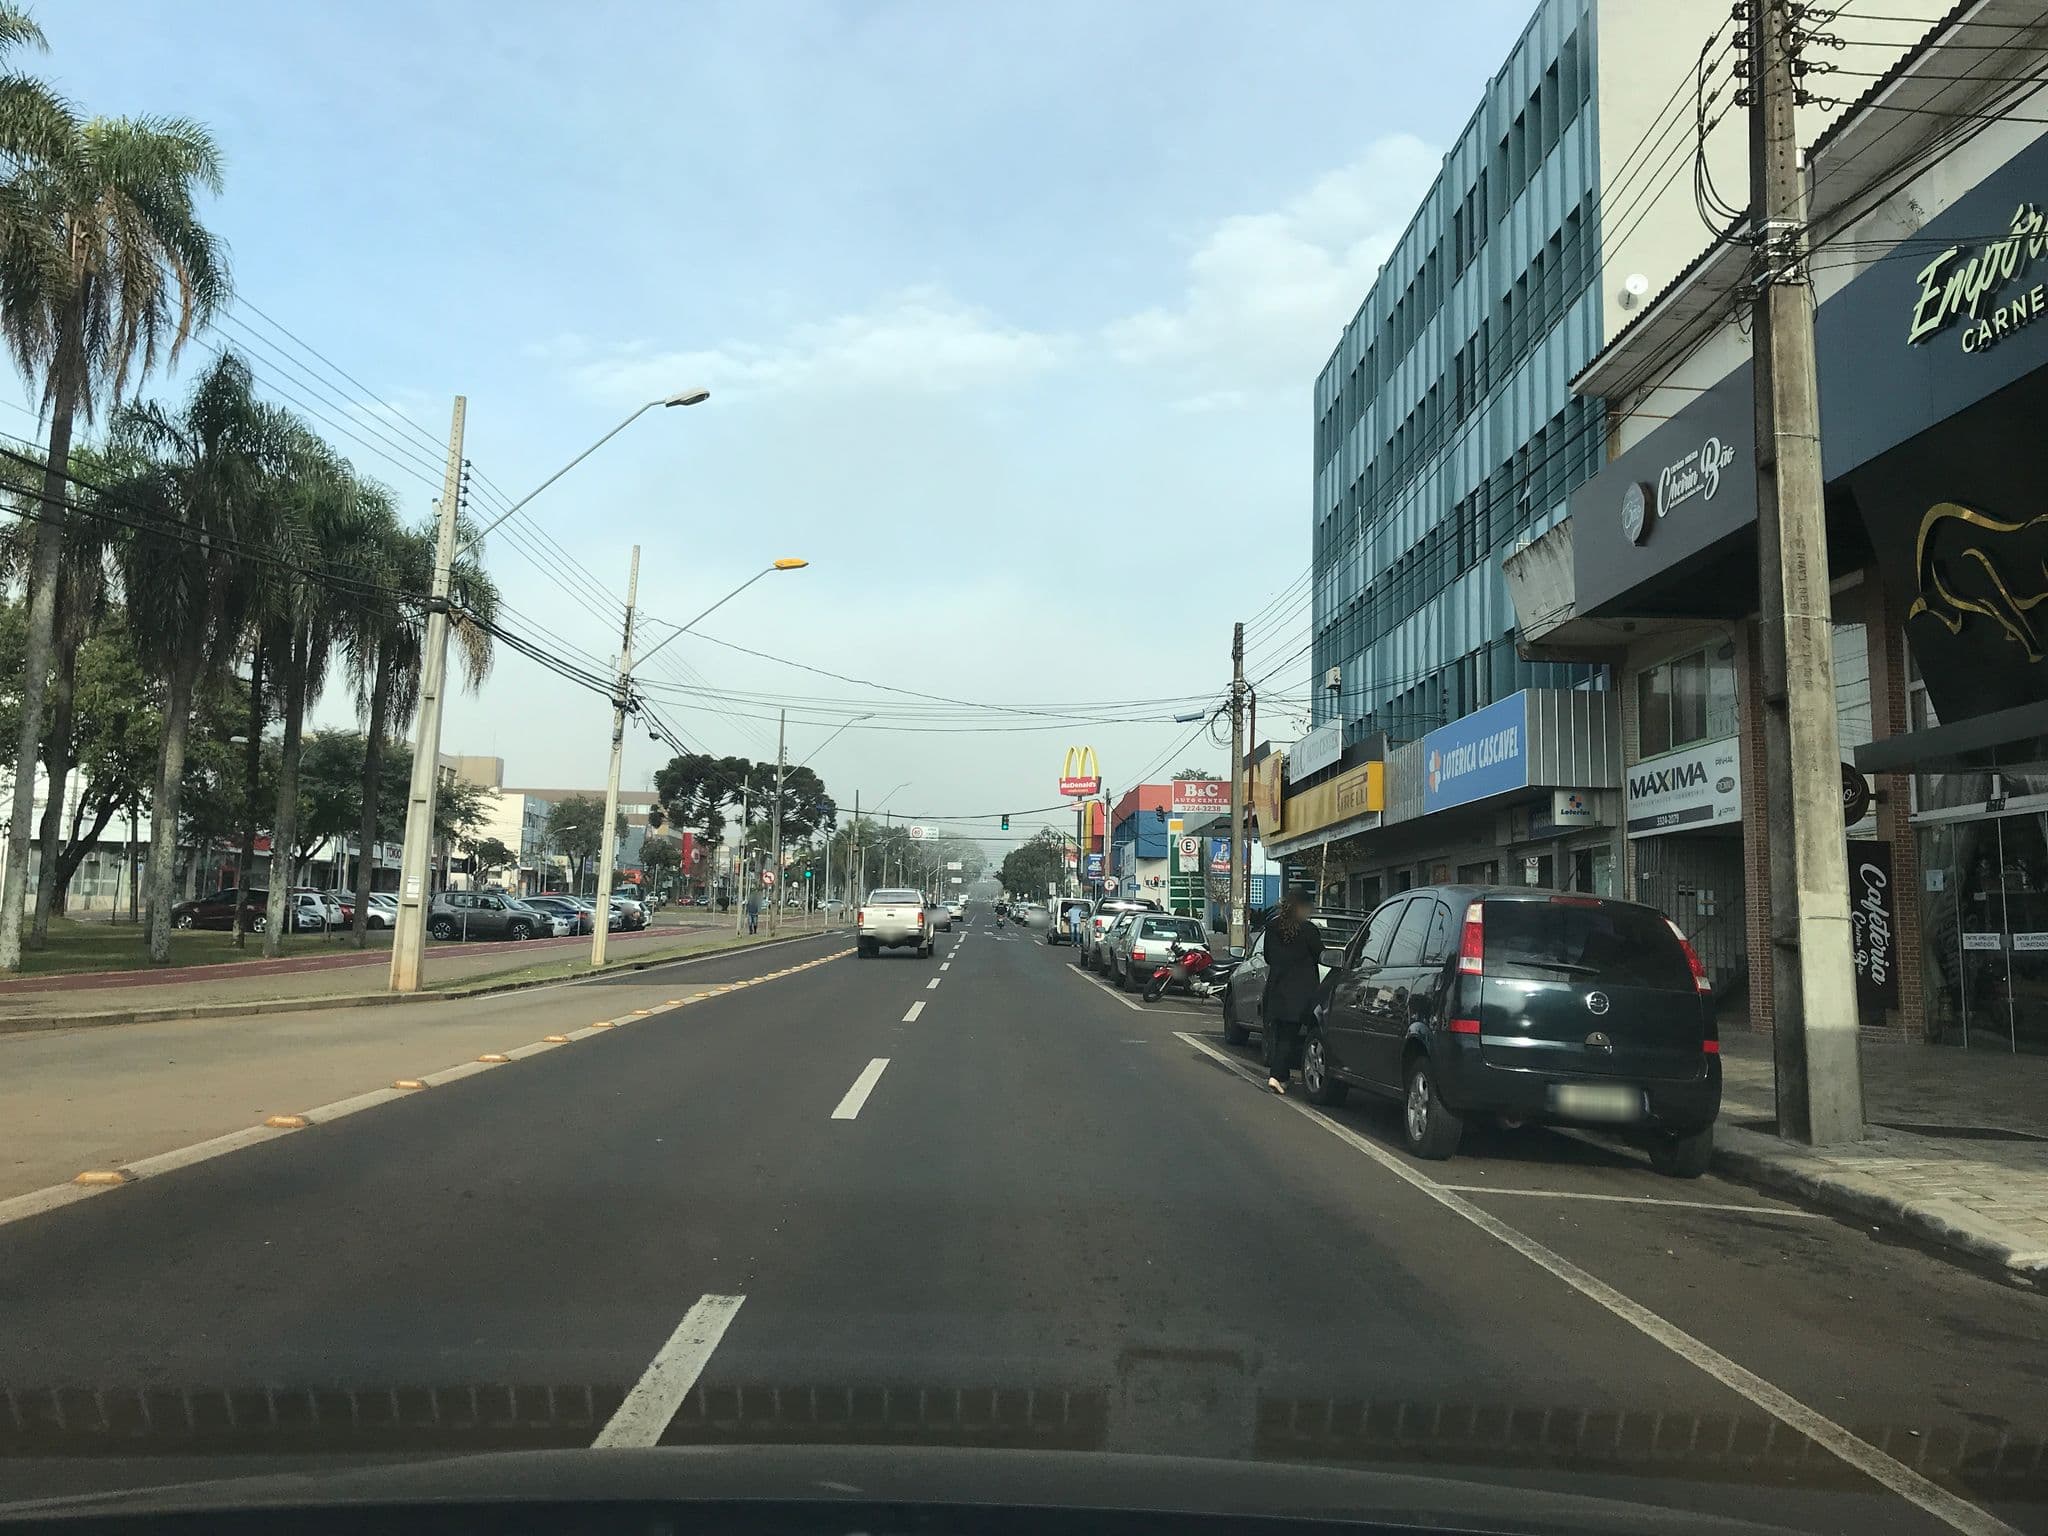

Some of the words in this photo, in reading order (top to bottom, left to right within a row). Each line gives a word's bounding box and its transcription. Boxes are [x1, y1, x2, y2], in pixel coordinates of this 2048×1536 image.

[1961, 284, 2046, 353] CARNE
[1442, 741, 1477, 781] LOTÉRICA
[1478, 726, 1519, 769] CASCAVEL
[1184, 783, 1218, 798] B&C
[1337, 772, 1368, 813] PIRELLI
[1629, 761, 1708, 800] MÁXIMA
[1185, 841, 1192, 851] E
[1860, 863, 1891, 986] Cafeteria
